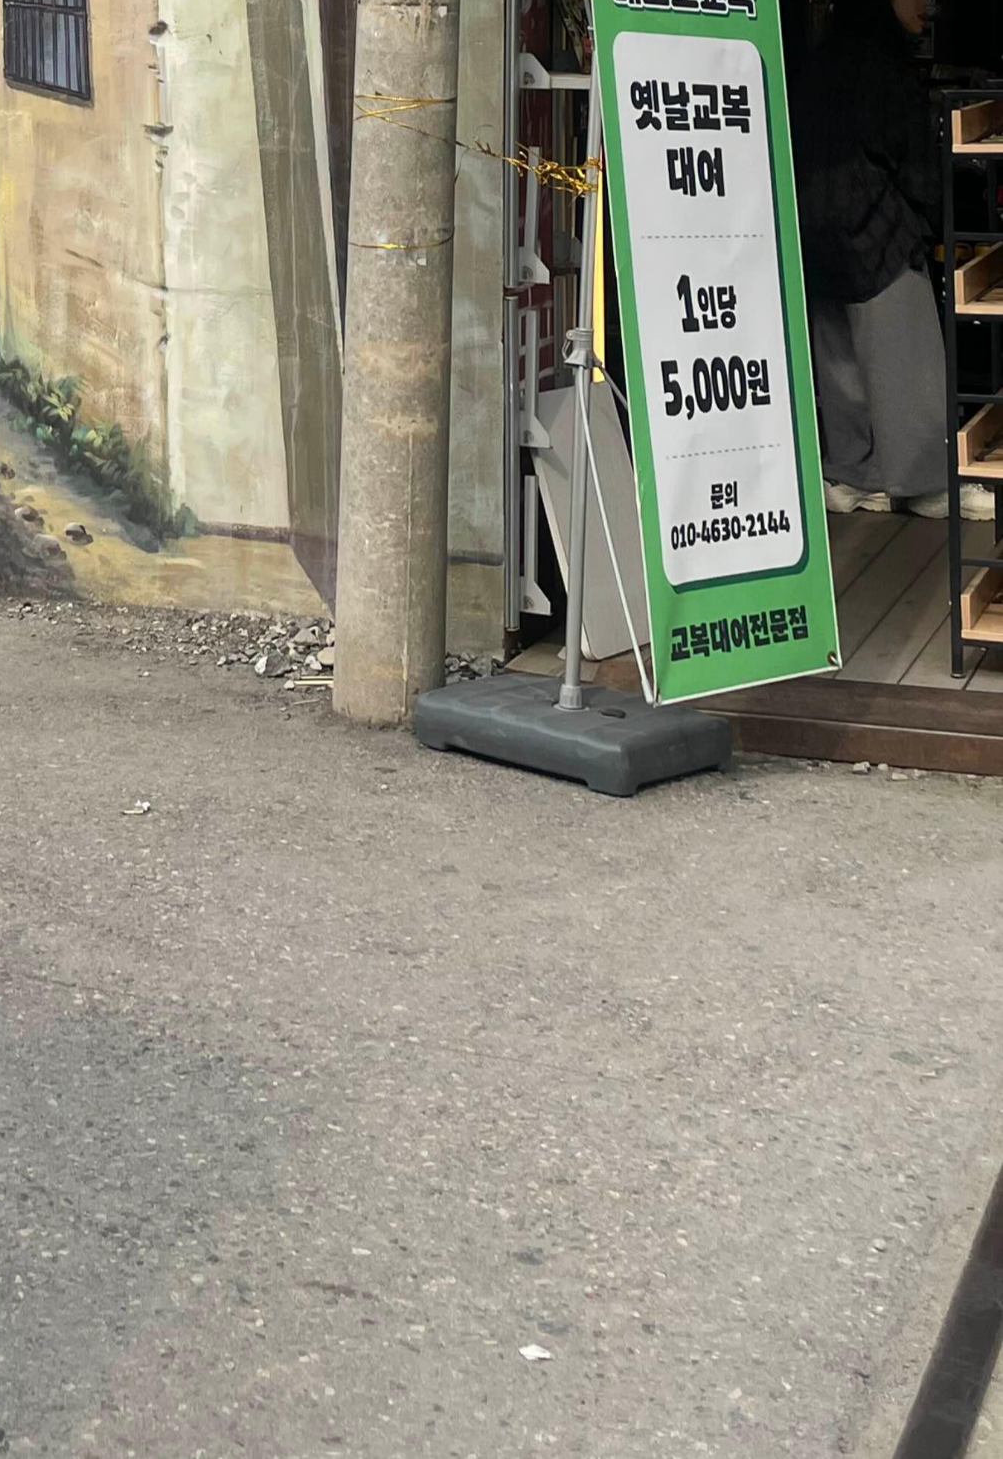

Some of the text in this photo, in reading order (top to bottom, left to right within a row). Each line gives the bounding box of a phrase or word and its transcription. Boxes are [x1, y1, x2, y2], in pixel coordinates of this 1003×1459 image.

[630, 79, 751, 134] 옛날교복
[666, 146, 726, 197] 대여
[676, 274, 737, 333] 1인당
[660, 354, 771, 420] 5,000원
[710, 480, 738, 510] 문의
[670, 509, 791, 551] 010-4630-2144
[671, 604, 809, 662] 교복대여전문점
